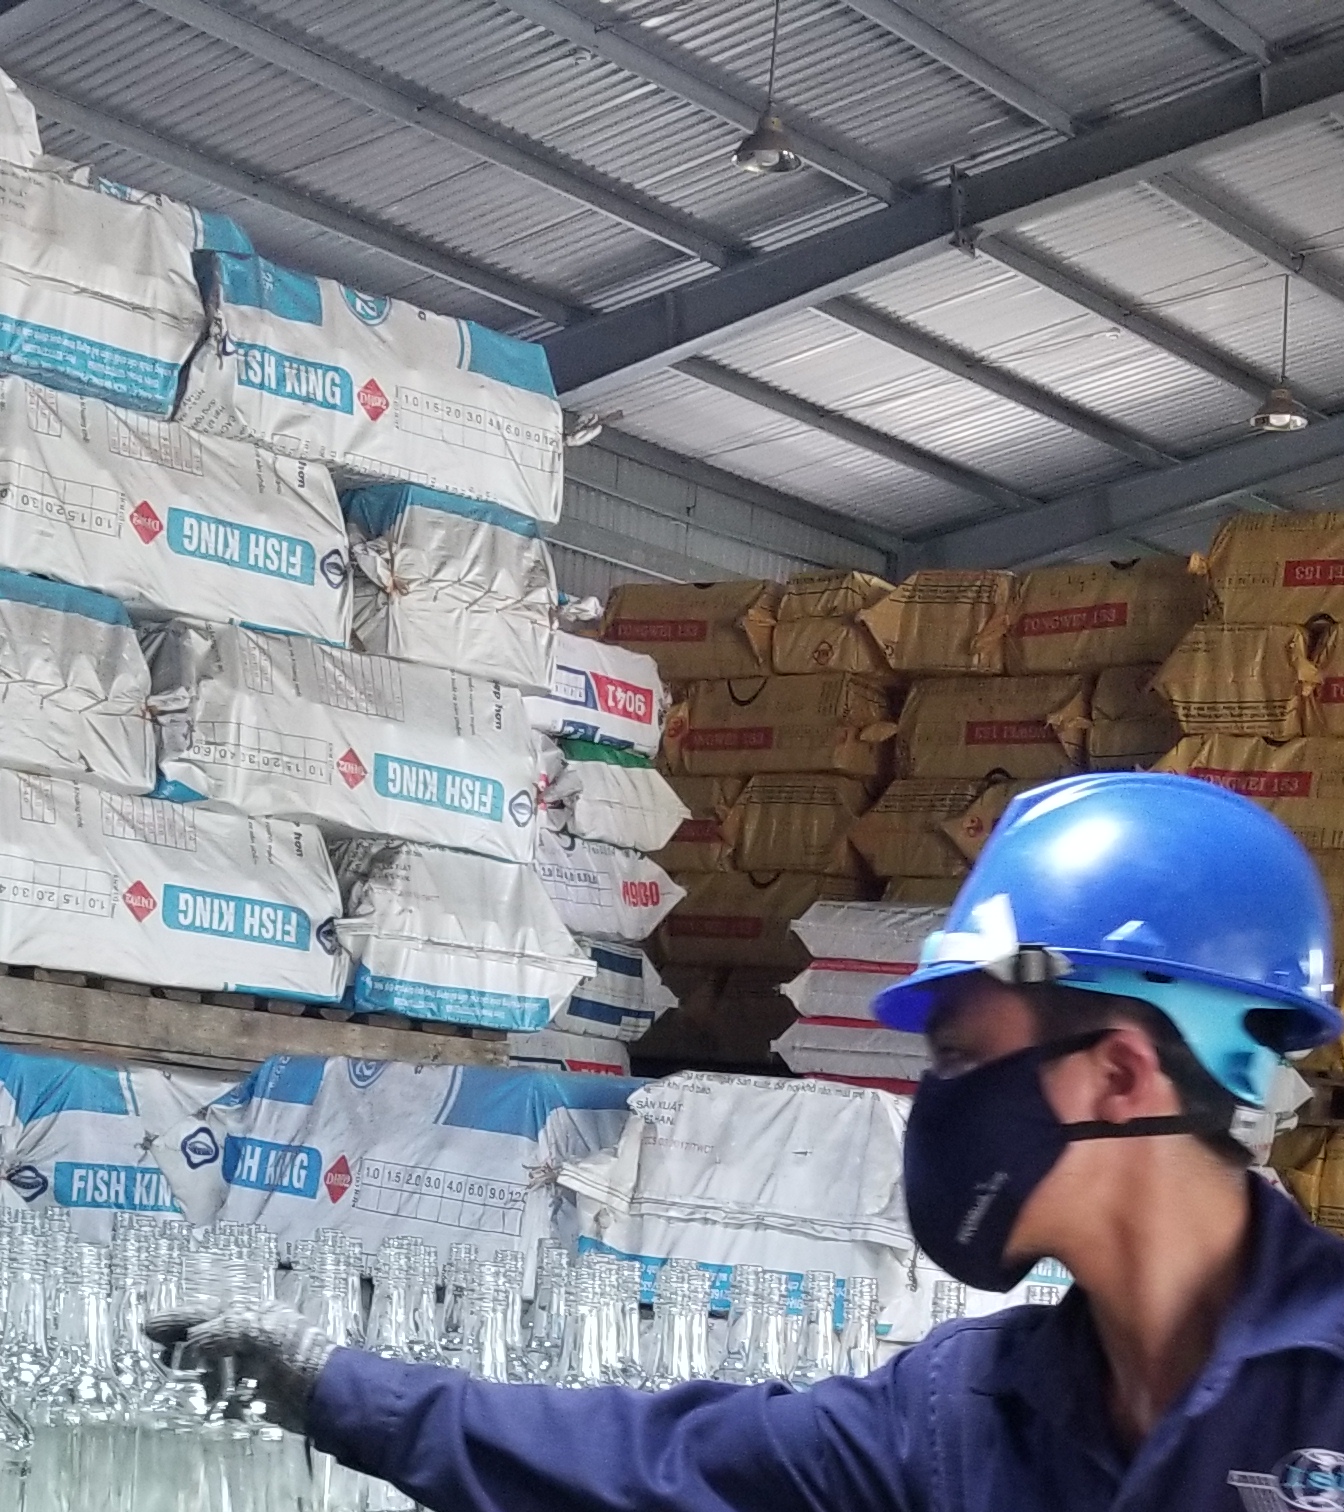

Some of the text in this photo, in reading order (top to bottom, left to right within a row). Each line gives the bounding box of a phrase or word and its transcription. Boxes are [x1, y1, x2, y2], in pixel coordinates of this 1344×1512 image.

[238, 350, 342, 407] ISH KING
[182, 516, 303, 577] FISH KING
[607, 683, 646, 716] 9041
[388, 762, 494, 814] FISH KING
[177, 891, 298, 944] FISH KING
[235, 1147, 261, 1183] SH
[364, 1166, 381, 1182] 1.0
[386, 1170, 402, 1184] 1.5
[405, 1172, 422, 1187] 2.0
[424, 1174, 442, 1190] 3.0
[446, 1179, 464, 1195] 4.0
[488, 1185, 506, 1201] 9.0
[72, 1168, 182, 1212] FISH KIN
